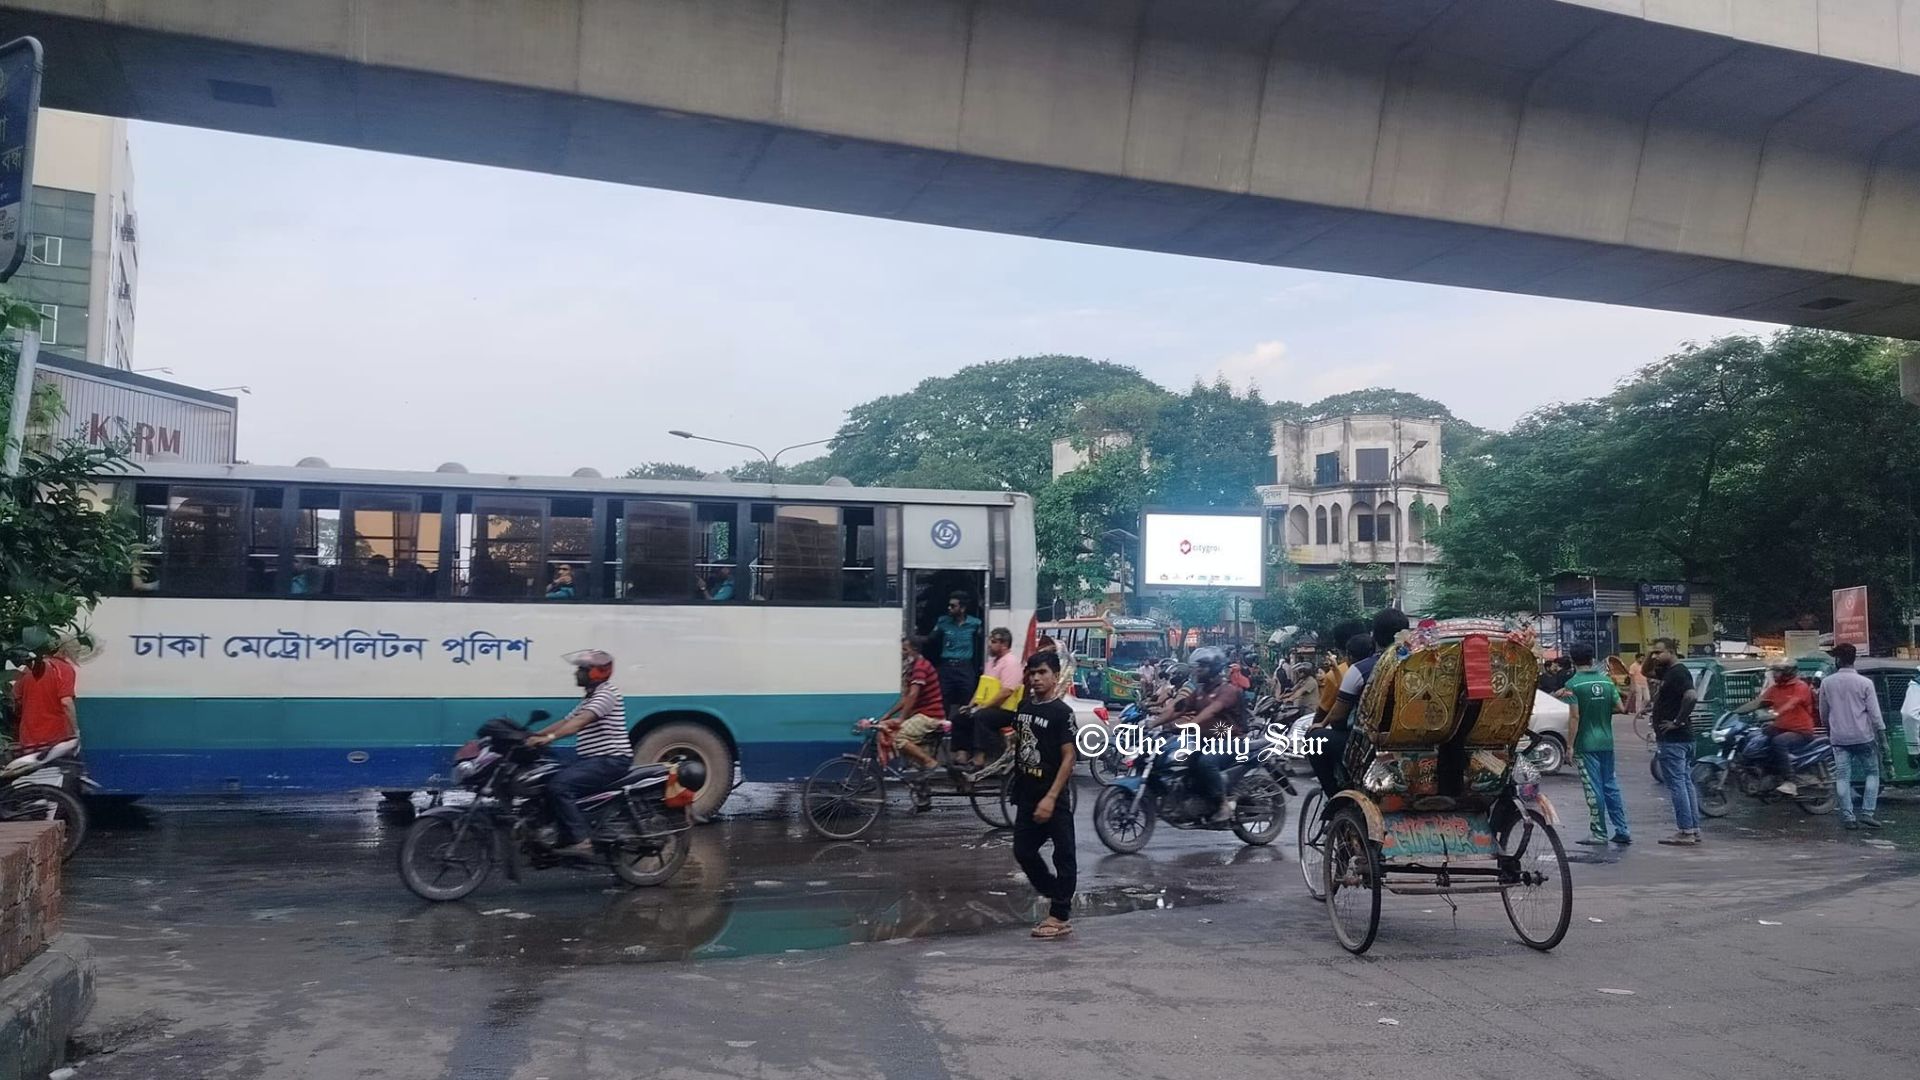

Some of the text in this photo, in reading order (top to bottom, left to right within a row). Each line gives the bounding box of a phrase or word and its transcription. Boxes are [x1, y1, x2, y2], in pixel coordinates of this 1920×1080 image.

[129, 628, 533, 665] ঢাকা মেট্রোপলিটন পুলিশ
